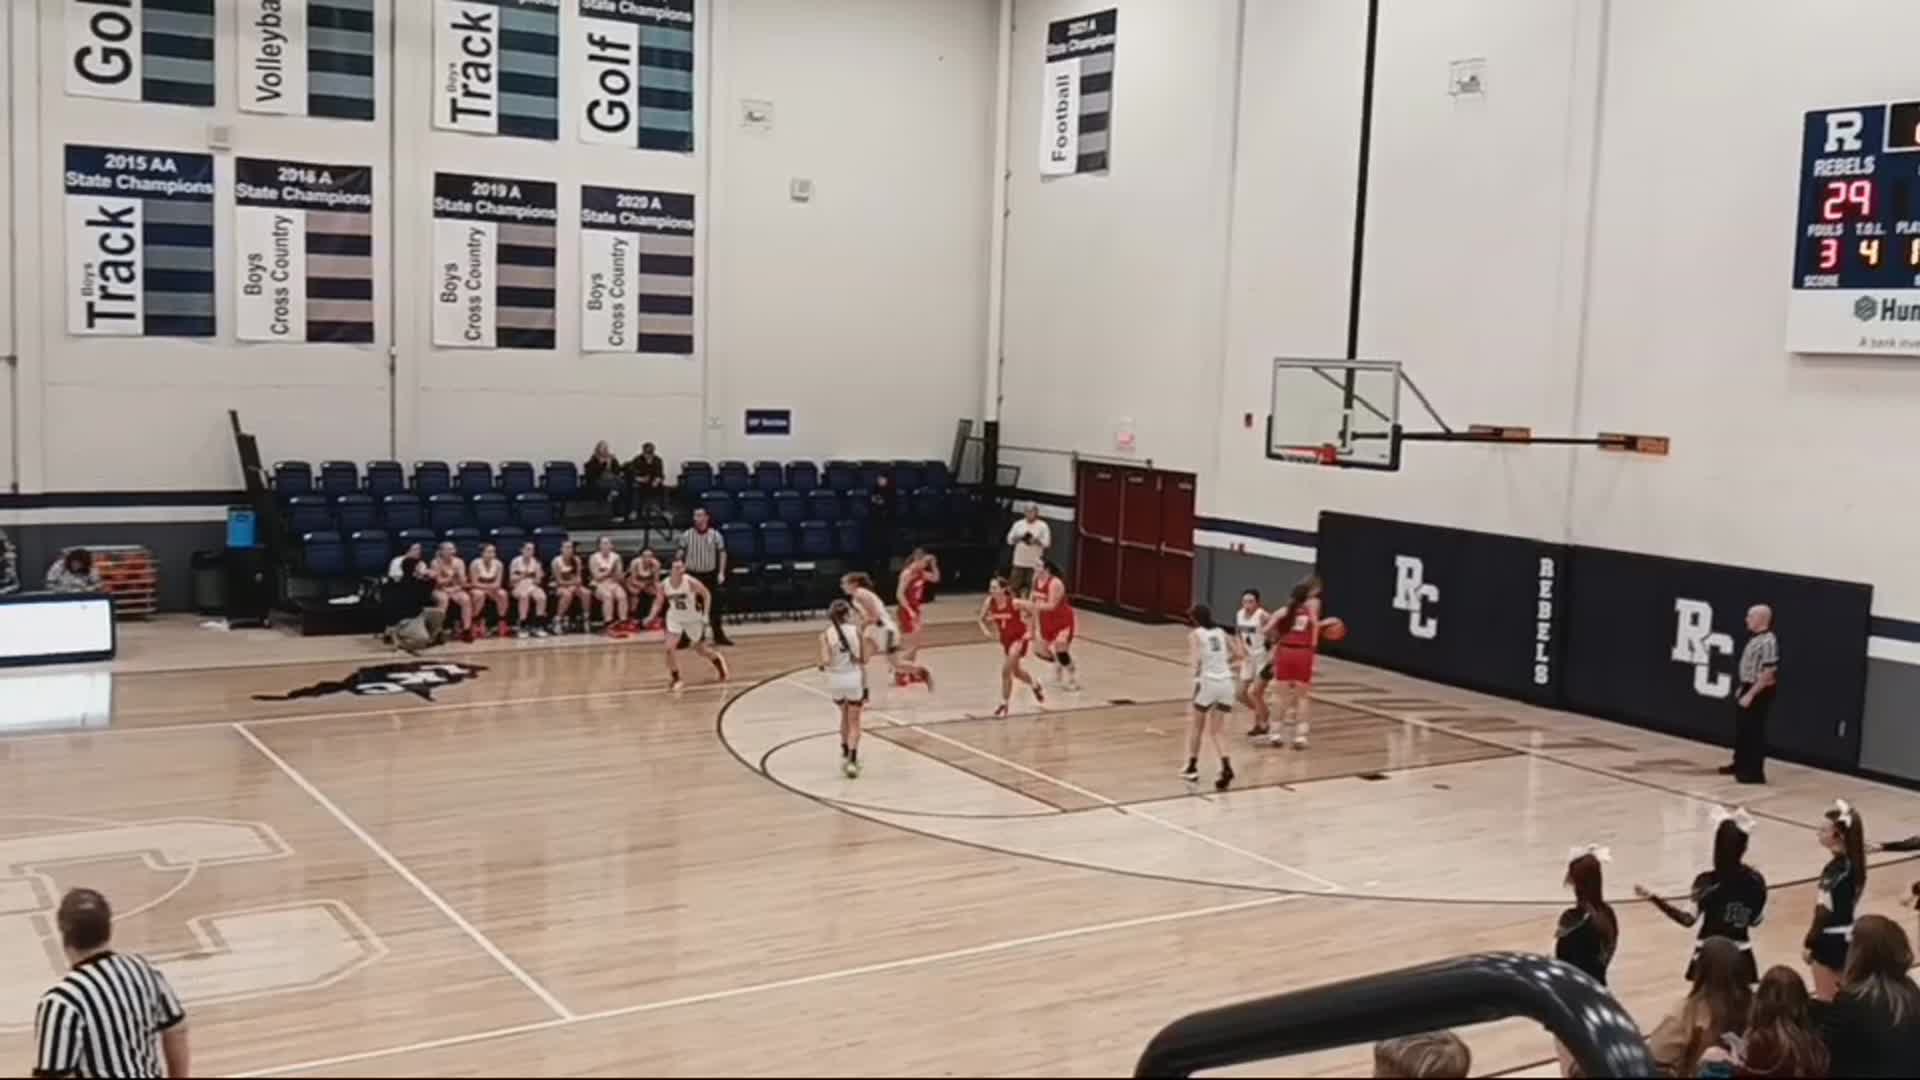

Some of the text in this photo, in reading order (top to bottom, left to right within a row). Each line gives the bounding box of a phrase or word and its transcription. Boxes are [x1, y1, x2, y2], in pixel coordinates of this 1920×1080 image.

[450, 10, 492, 123] Track
[586, 33, 631, 133] Golf
[1052, 75, 1070, 162] Football
[1824, 111, 1863, 153] R
[104, 153, 177, 173] 2015 AA
[318, 170, 333, 185] A
[1814, 155, 1875, 177] REBELS
[66, 171, 213, 195] State Champions
[235, 182, 371, 206] State Champions
[509, 184, 522, 199] A
[1824, 180, 1871, 219] 29
[432, 197, 558, 220] State Champions
[619, 212, 694, 230] Champions
[650, 196, 662, 211] A
[85, 206, 136, 328] Track
[1820, 239, 1838, 268] 3
[1859, 239, 1879, 265] 4
[244, 254, 267, 296] Boys
[270, 216, 294, 335] Cross Country
[441, 263, 461, 303] Boys
[465, 228, 486, 341] Cross Country
[588, 273, 608, 311] Boys
[609, 237, 629, 346] Cross Country
[1535, 558, 1554, 684] REBELS
